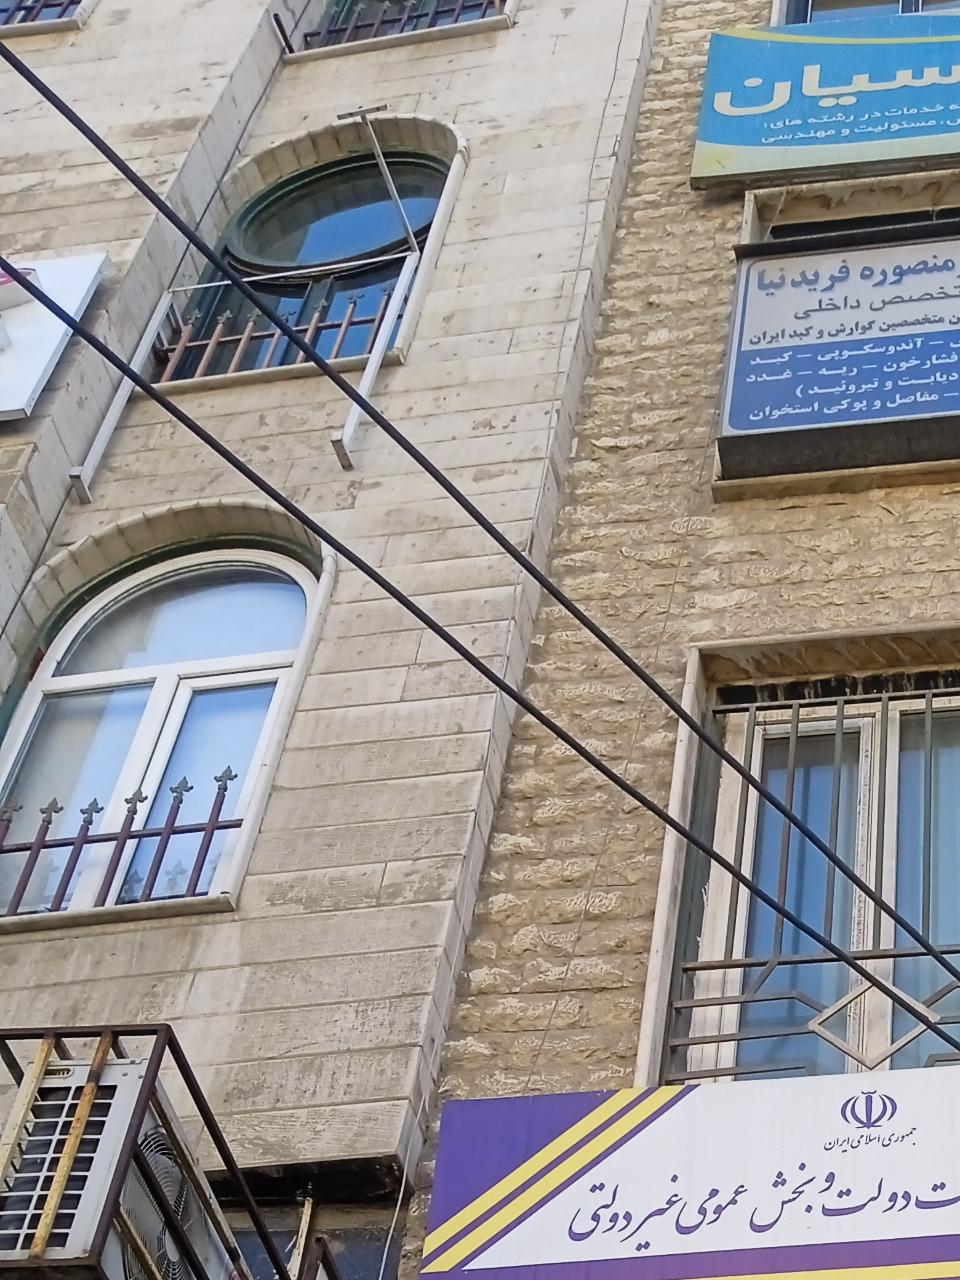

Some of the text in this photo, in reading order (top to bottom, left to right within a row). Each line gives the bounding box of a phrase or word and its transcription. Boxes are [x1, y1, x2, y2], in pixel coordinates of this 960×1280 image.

[859, 111, 881, 121] در
[885, 103, 944, 117] خدمات
[807, 112, 854, 125] رشته
[854, 119, 936, 134] مسئولیت
[761, 128, 836, 144] مهندسی
[841, 128, 850, 136] و
[756, 259, 851, 297] فریدنیا
[858, 254, 956, 288] منصوره
[794, 295, 861, 320] داخلی
[878, 314, 945, 332] متخصصین
[749, 328, 786, 345] ایران
[788, 325, 813, 341] کبد
[816, 328, 824, 340] و
[816, 337, 925, 361] آندوسکوپی
[750, 352, 793, 366] کبد
[746, 368, 793, 383] غدد
[818, 366, 858, 376] ریه
[897, 371, 959, 387] دیابت
[808, 377, 879, 395] تیروئید
[883, 380, 893, 391] و
[823, 398, 868, 414] پوکی
[871, 400, 881, 410] و
[886, 390, 939, 408] مفاصل
[749, 401, 819, 421] استخوان
[823, 1127, 917, 1153] جمهوری اسلامی ایران
[818, 1171, 836, 1194] و
[749, 1162, 816, 1234] بخش
[820, 1176, 912, 1218] دولت
[675, 1182, 748, 1236] عمومی
